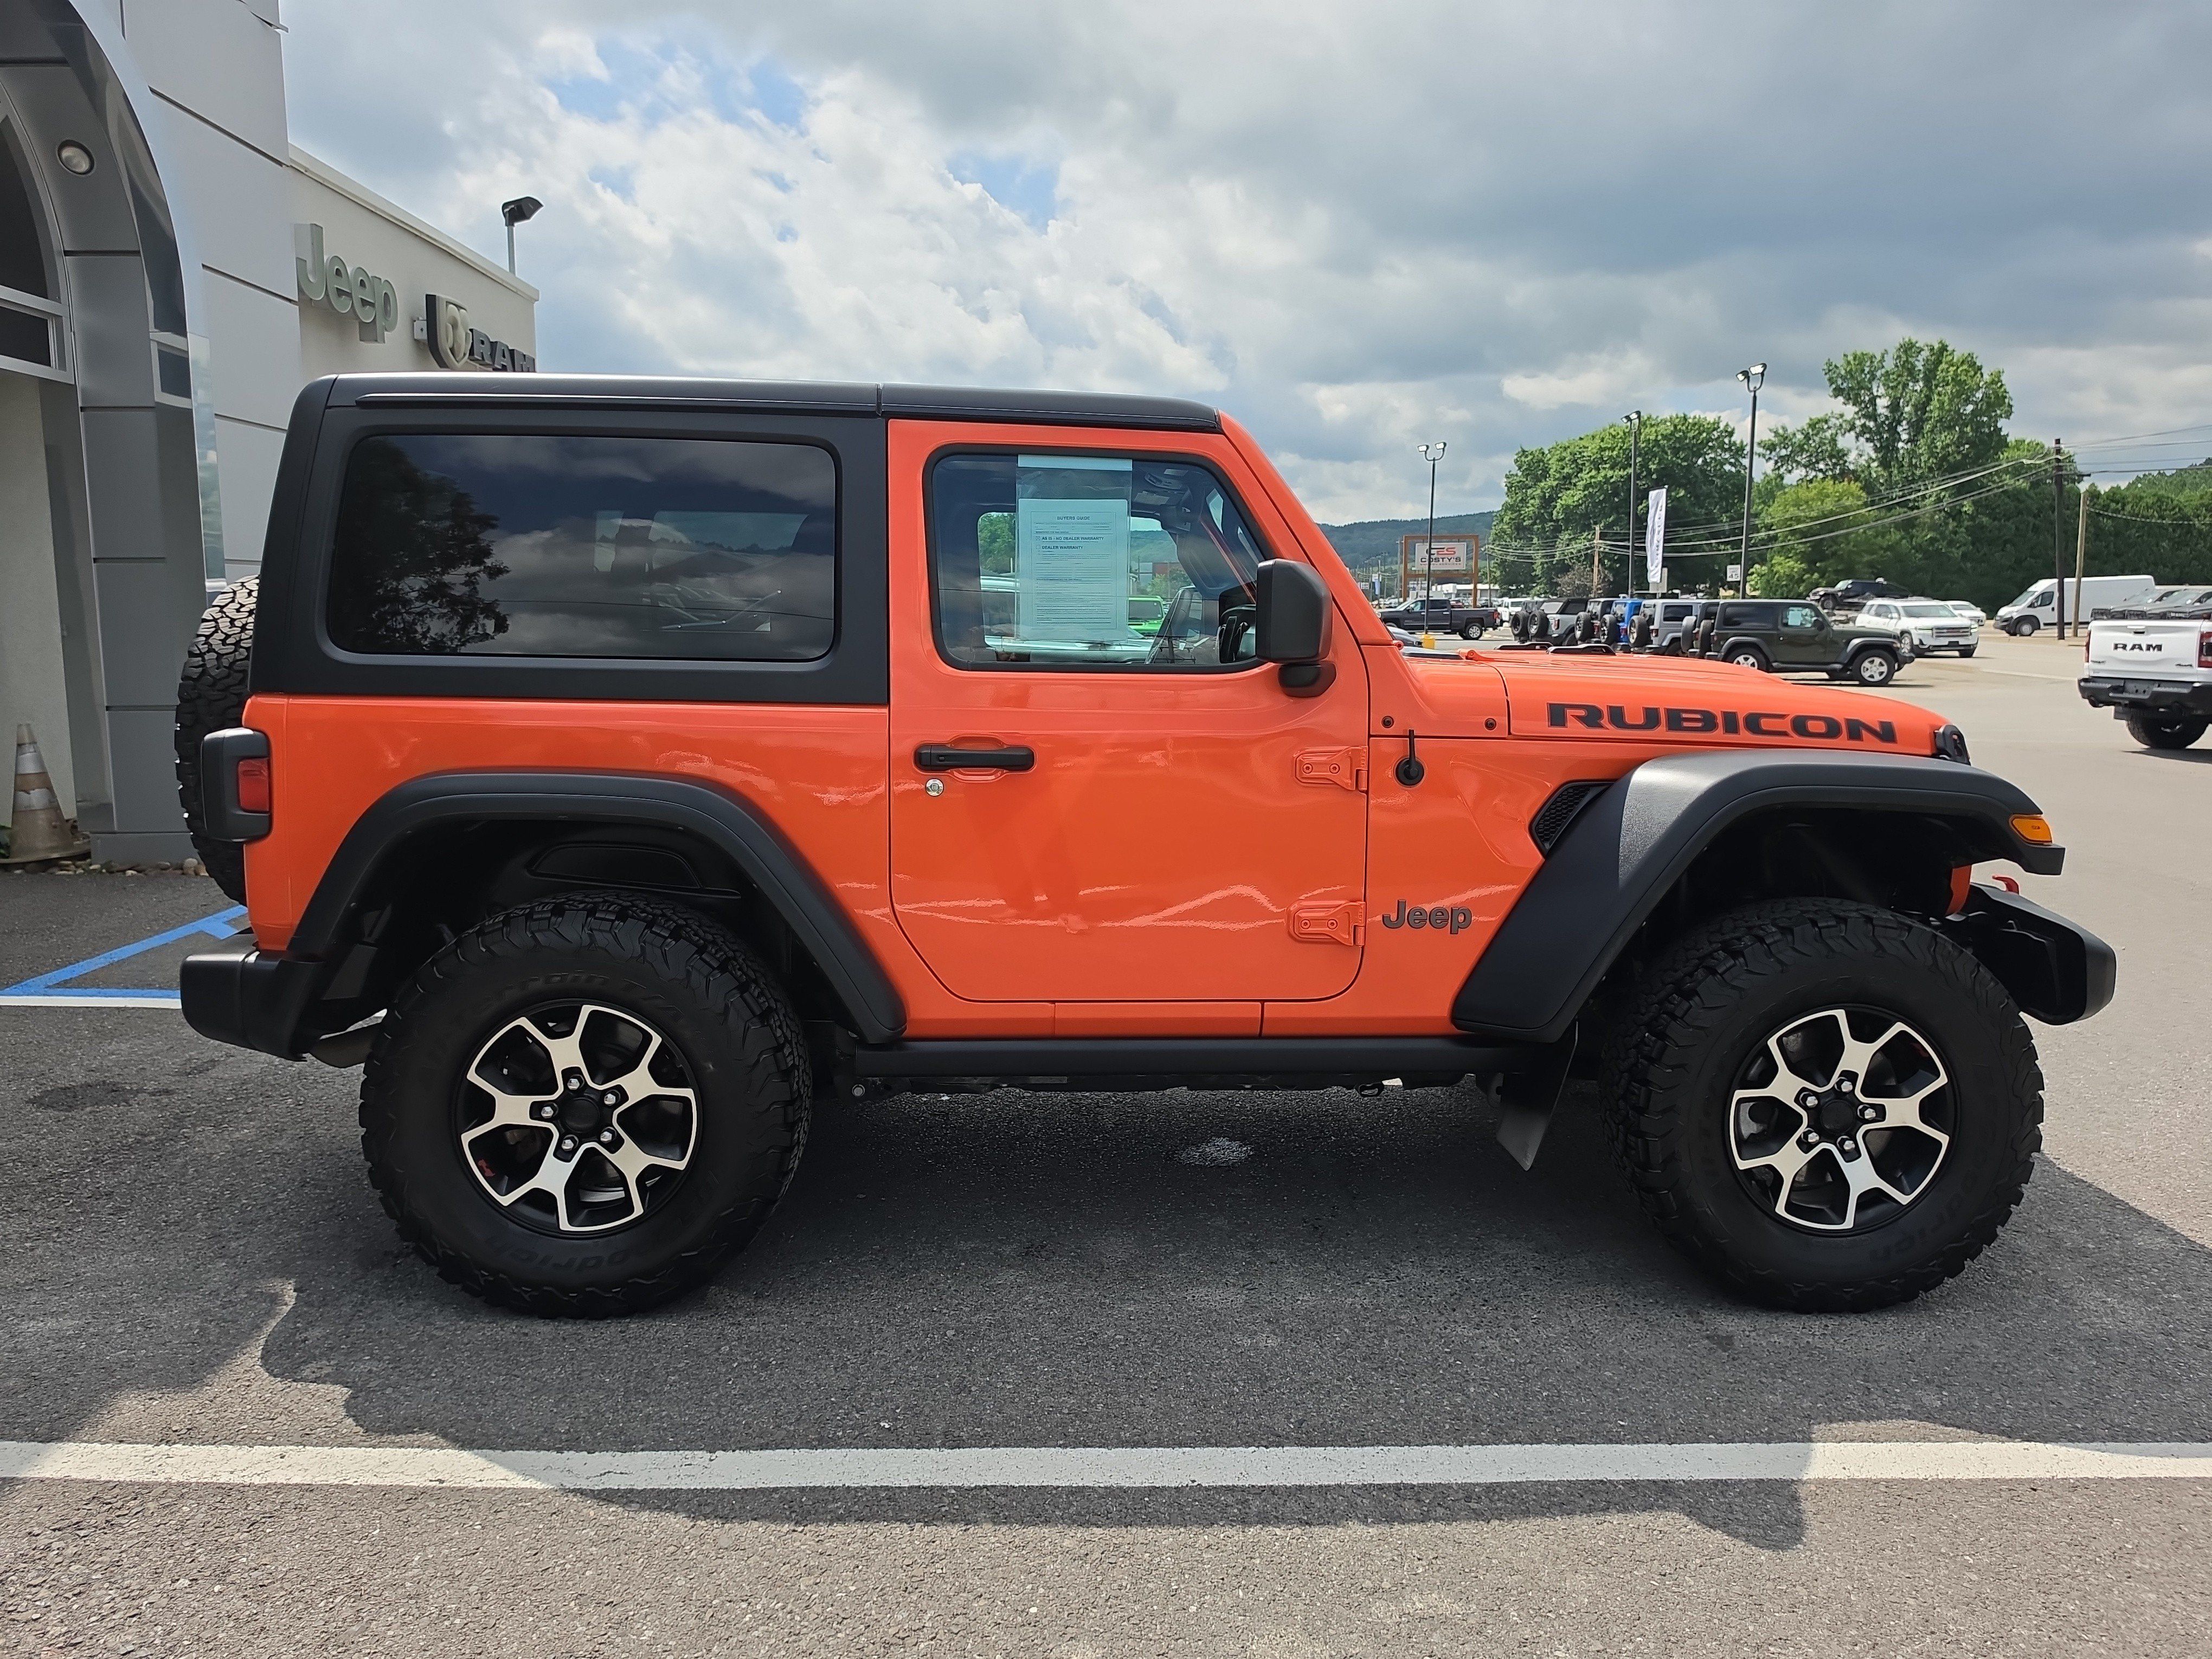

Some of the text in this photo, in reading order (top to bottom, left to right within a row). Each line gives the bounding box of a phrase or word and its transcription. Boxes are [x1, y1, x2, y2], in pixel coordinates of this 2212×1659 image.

[294, 223, 398, 344] Jeep
[470, 329, 536, 372] RAM
[2113, 643, 2163, 652] RAM
[1546, 702, 1898, 744] RUBICON
[1382, 899, 1472, 935] Jeep
